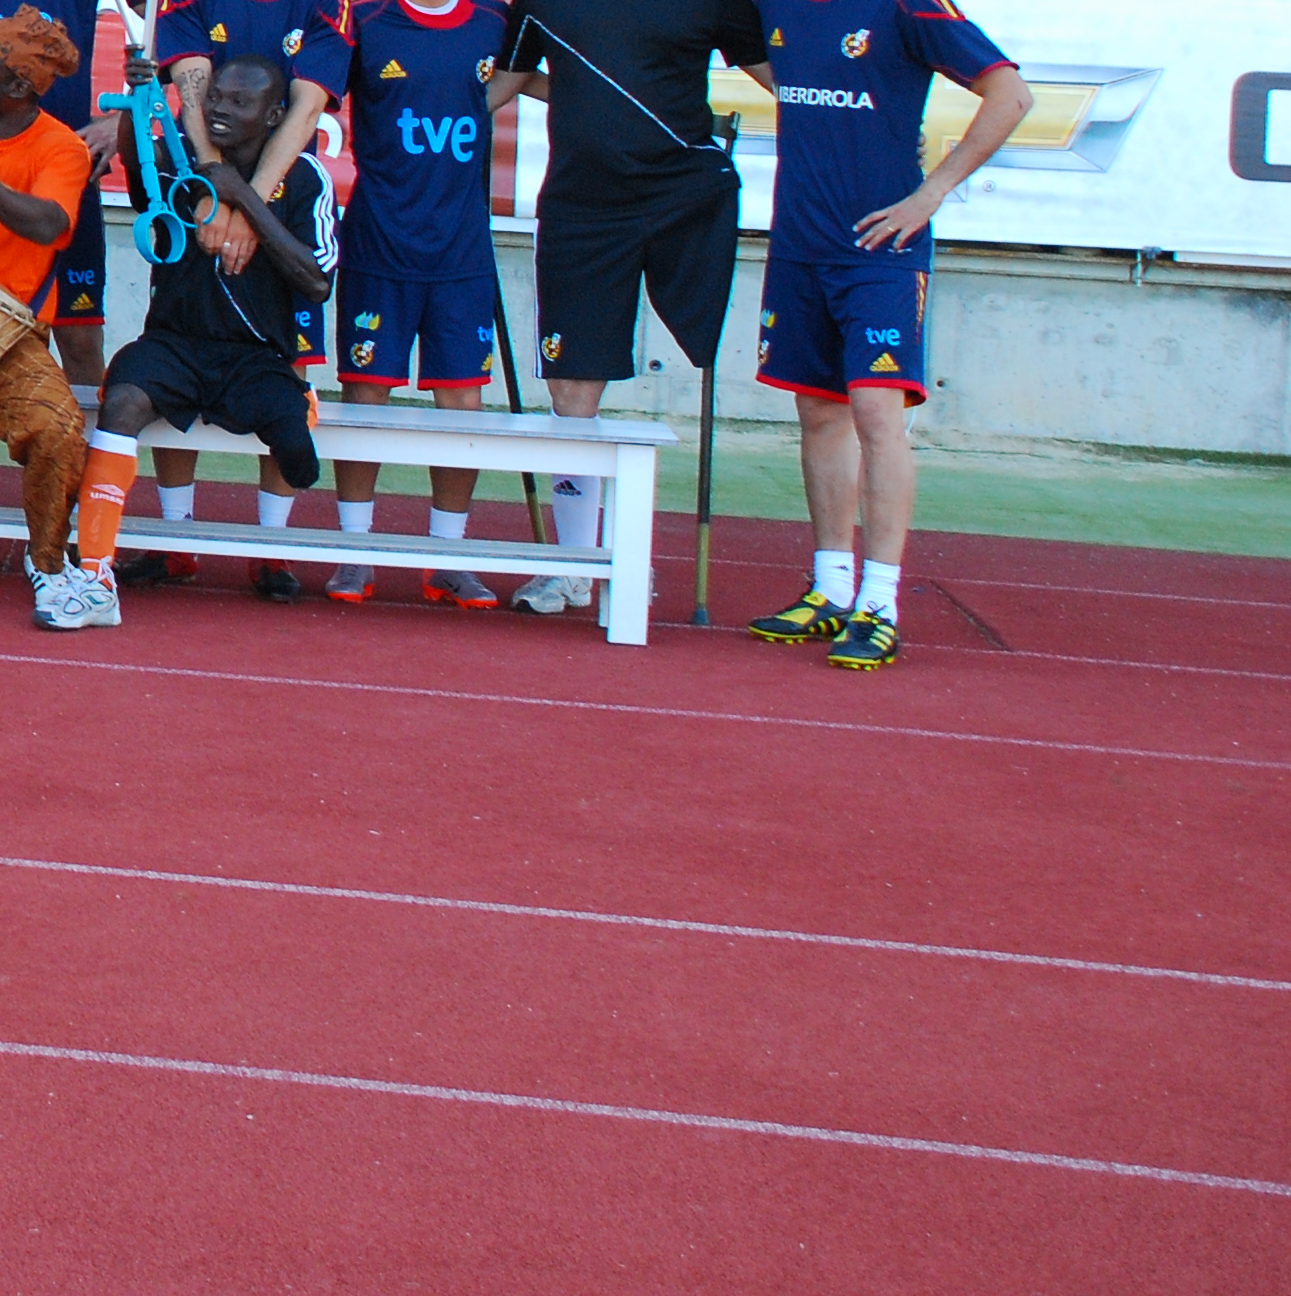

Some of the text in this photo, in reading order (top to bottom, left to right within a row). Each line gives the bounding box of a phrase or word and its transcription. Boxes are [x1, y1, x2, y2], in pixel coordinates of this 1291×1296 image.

[779, 85, 874, 109] IBERDROLA
[396, 107, 477, 163] tve
[67, 268, 95, 285] tve
[865, 327, 901, 346] tve
